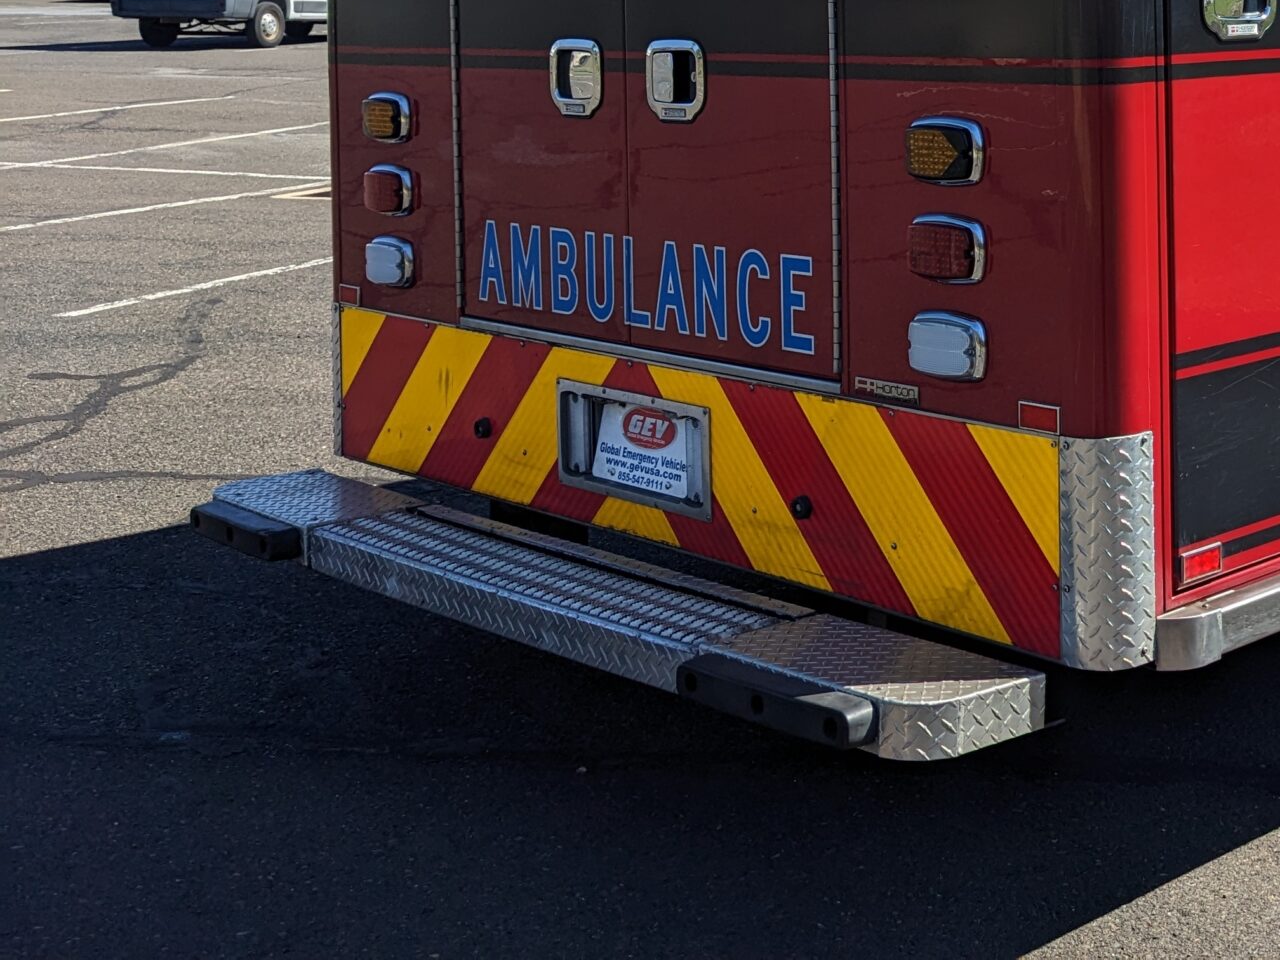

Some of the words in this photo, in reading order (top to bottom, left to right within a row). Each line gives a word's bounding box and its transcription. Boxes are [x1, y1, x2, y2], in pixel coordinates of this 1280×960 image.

[479, 219, 815, 355] AMBULANCE
[876, 381, 916, 399] Horton
[628, 414, 670, 439] GEV
[600, 442, 621, 456] Global
[622, 447, 659, 468] Emergency
[605, 456, 682, 482] www.gevusa.com
[617, 471, 663, 490] 855-547-9111
